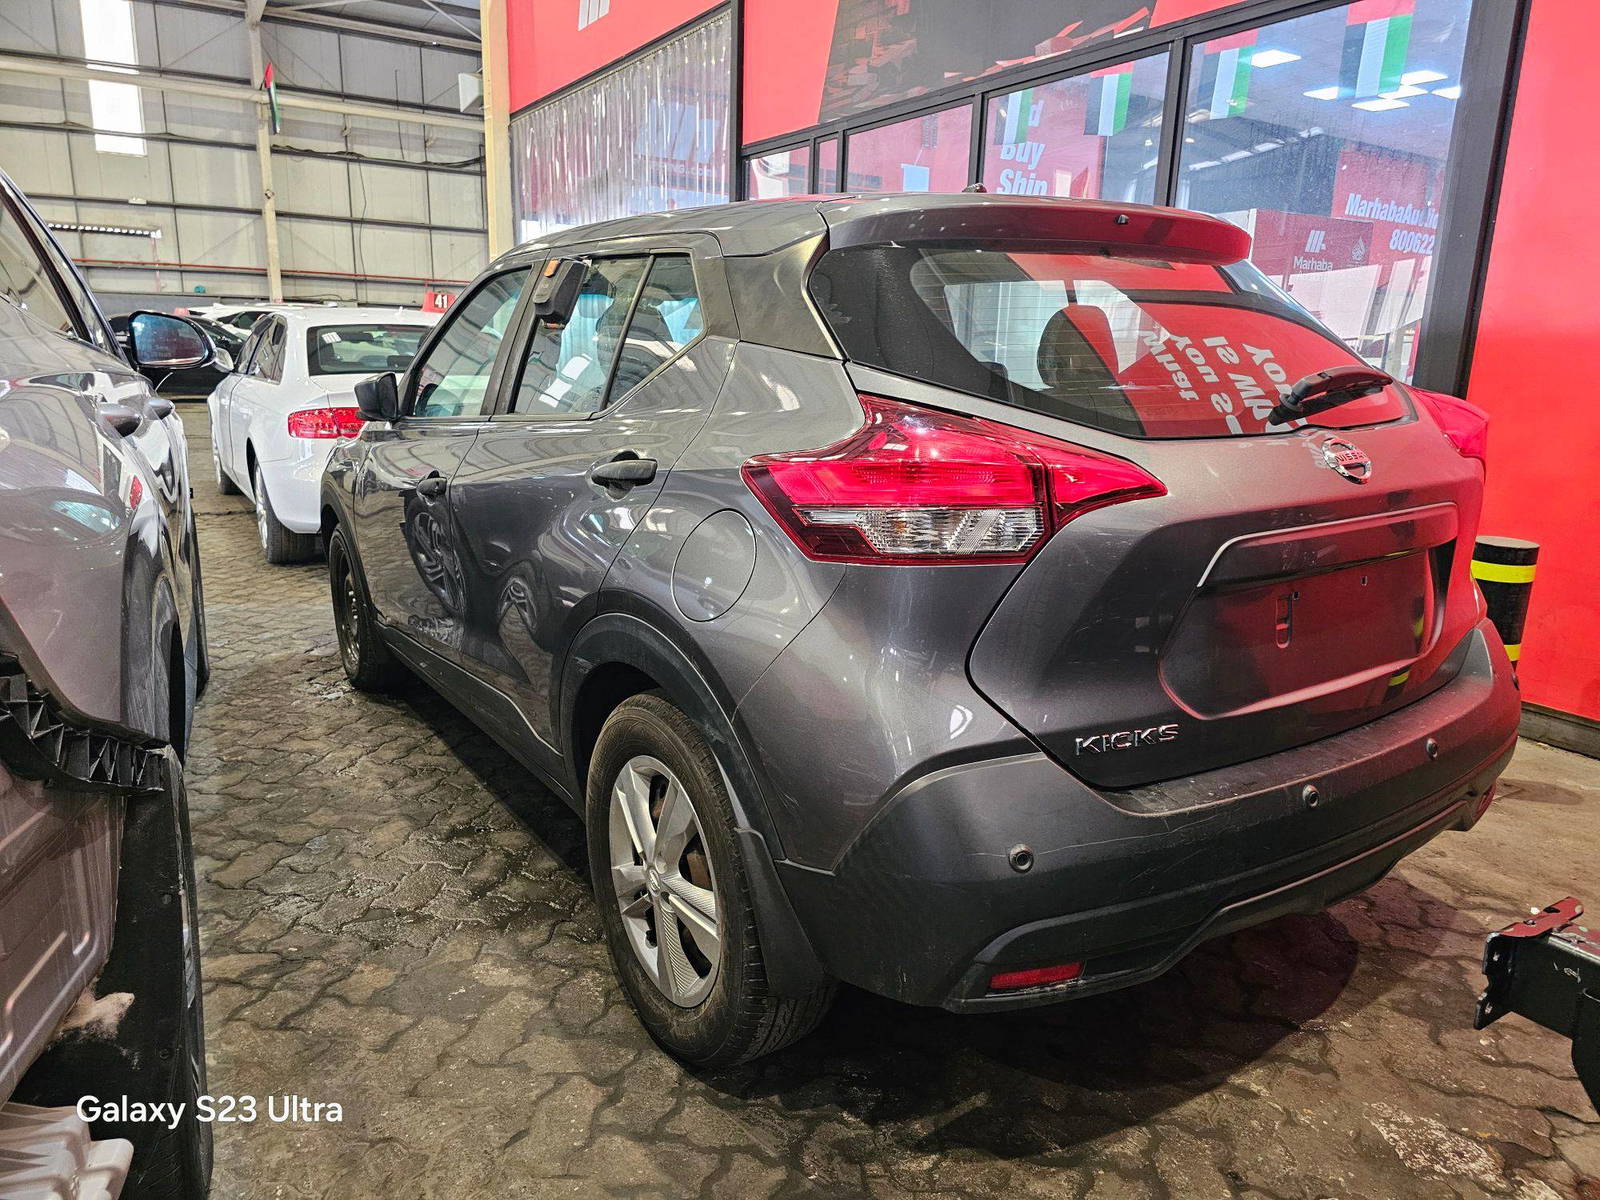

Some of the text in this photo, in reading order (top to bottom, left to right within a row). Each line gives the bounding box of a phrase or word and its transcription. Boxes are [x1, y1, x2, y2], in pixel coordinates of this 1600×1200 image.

[1000, 141, 1046, 170] Buy
[1293, 255, 1334, 271] Marhaba
[434, 294, 448, 309] 41
[1075, 723, 1179, 756] KICKS
